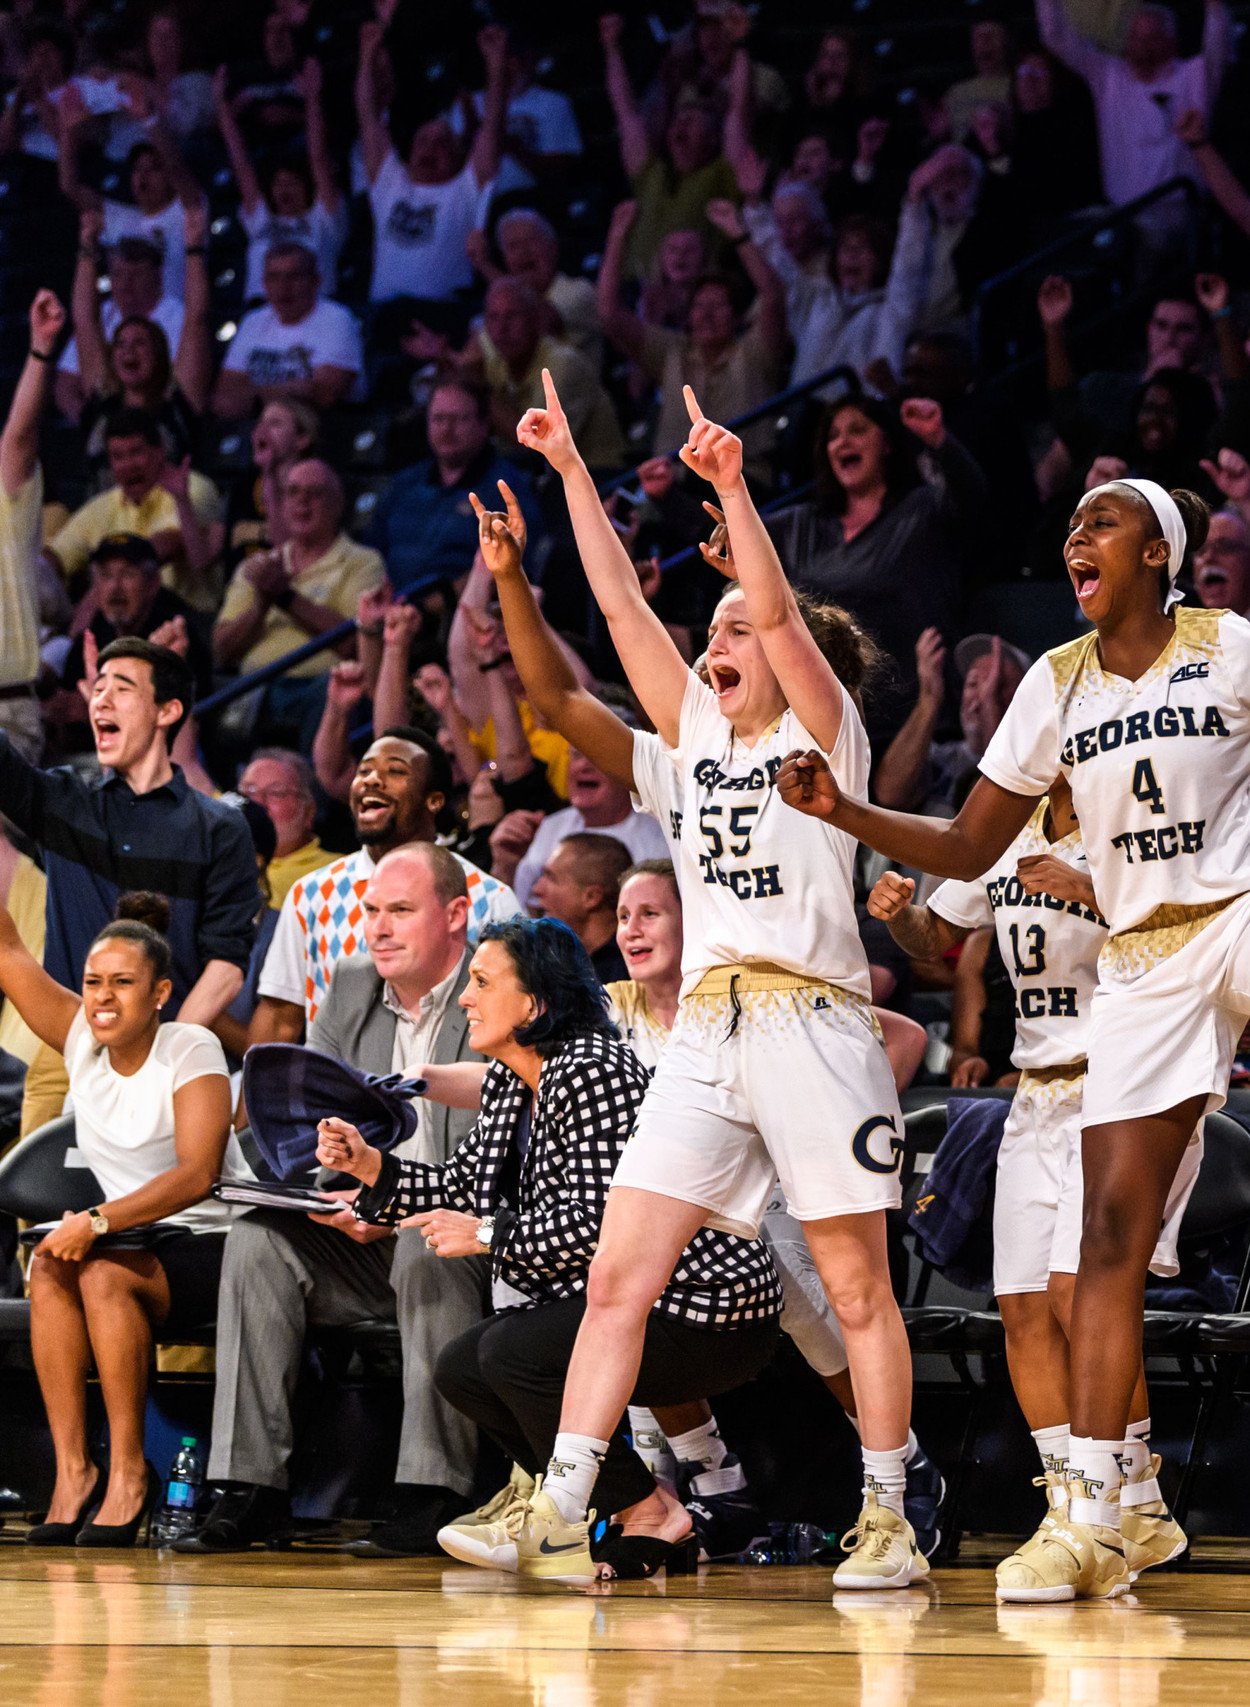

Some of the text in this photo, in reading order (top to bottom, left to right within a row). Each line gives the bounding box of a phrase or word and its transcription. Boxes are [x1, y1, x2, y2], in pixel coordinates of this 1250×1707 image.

[1170, 662, 1209, 683] ACC
[1060, 706, 1230, 766] GEORGIA
[1132, 757, 1167, 816] 4
[700, 805, 759, 859] 55
[1111, 820, 1206, 864] TECH
[1009, 923, 1047, 977] 13
[914, 1194, 935, 1215] 4
